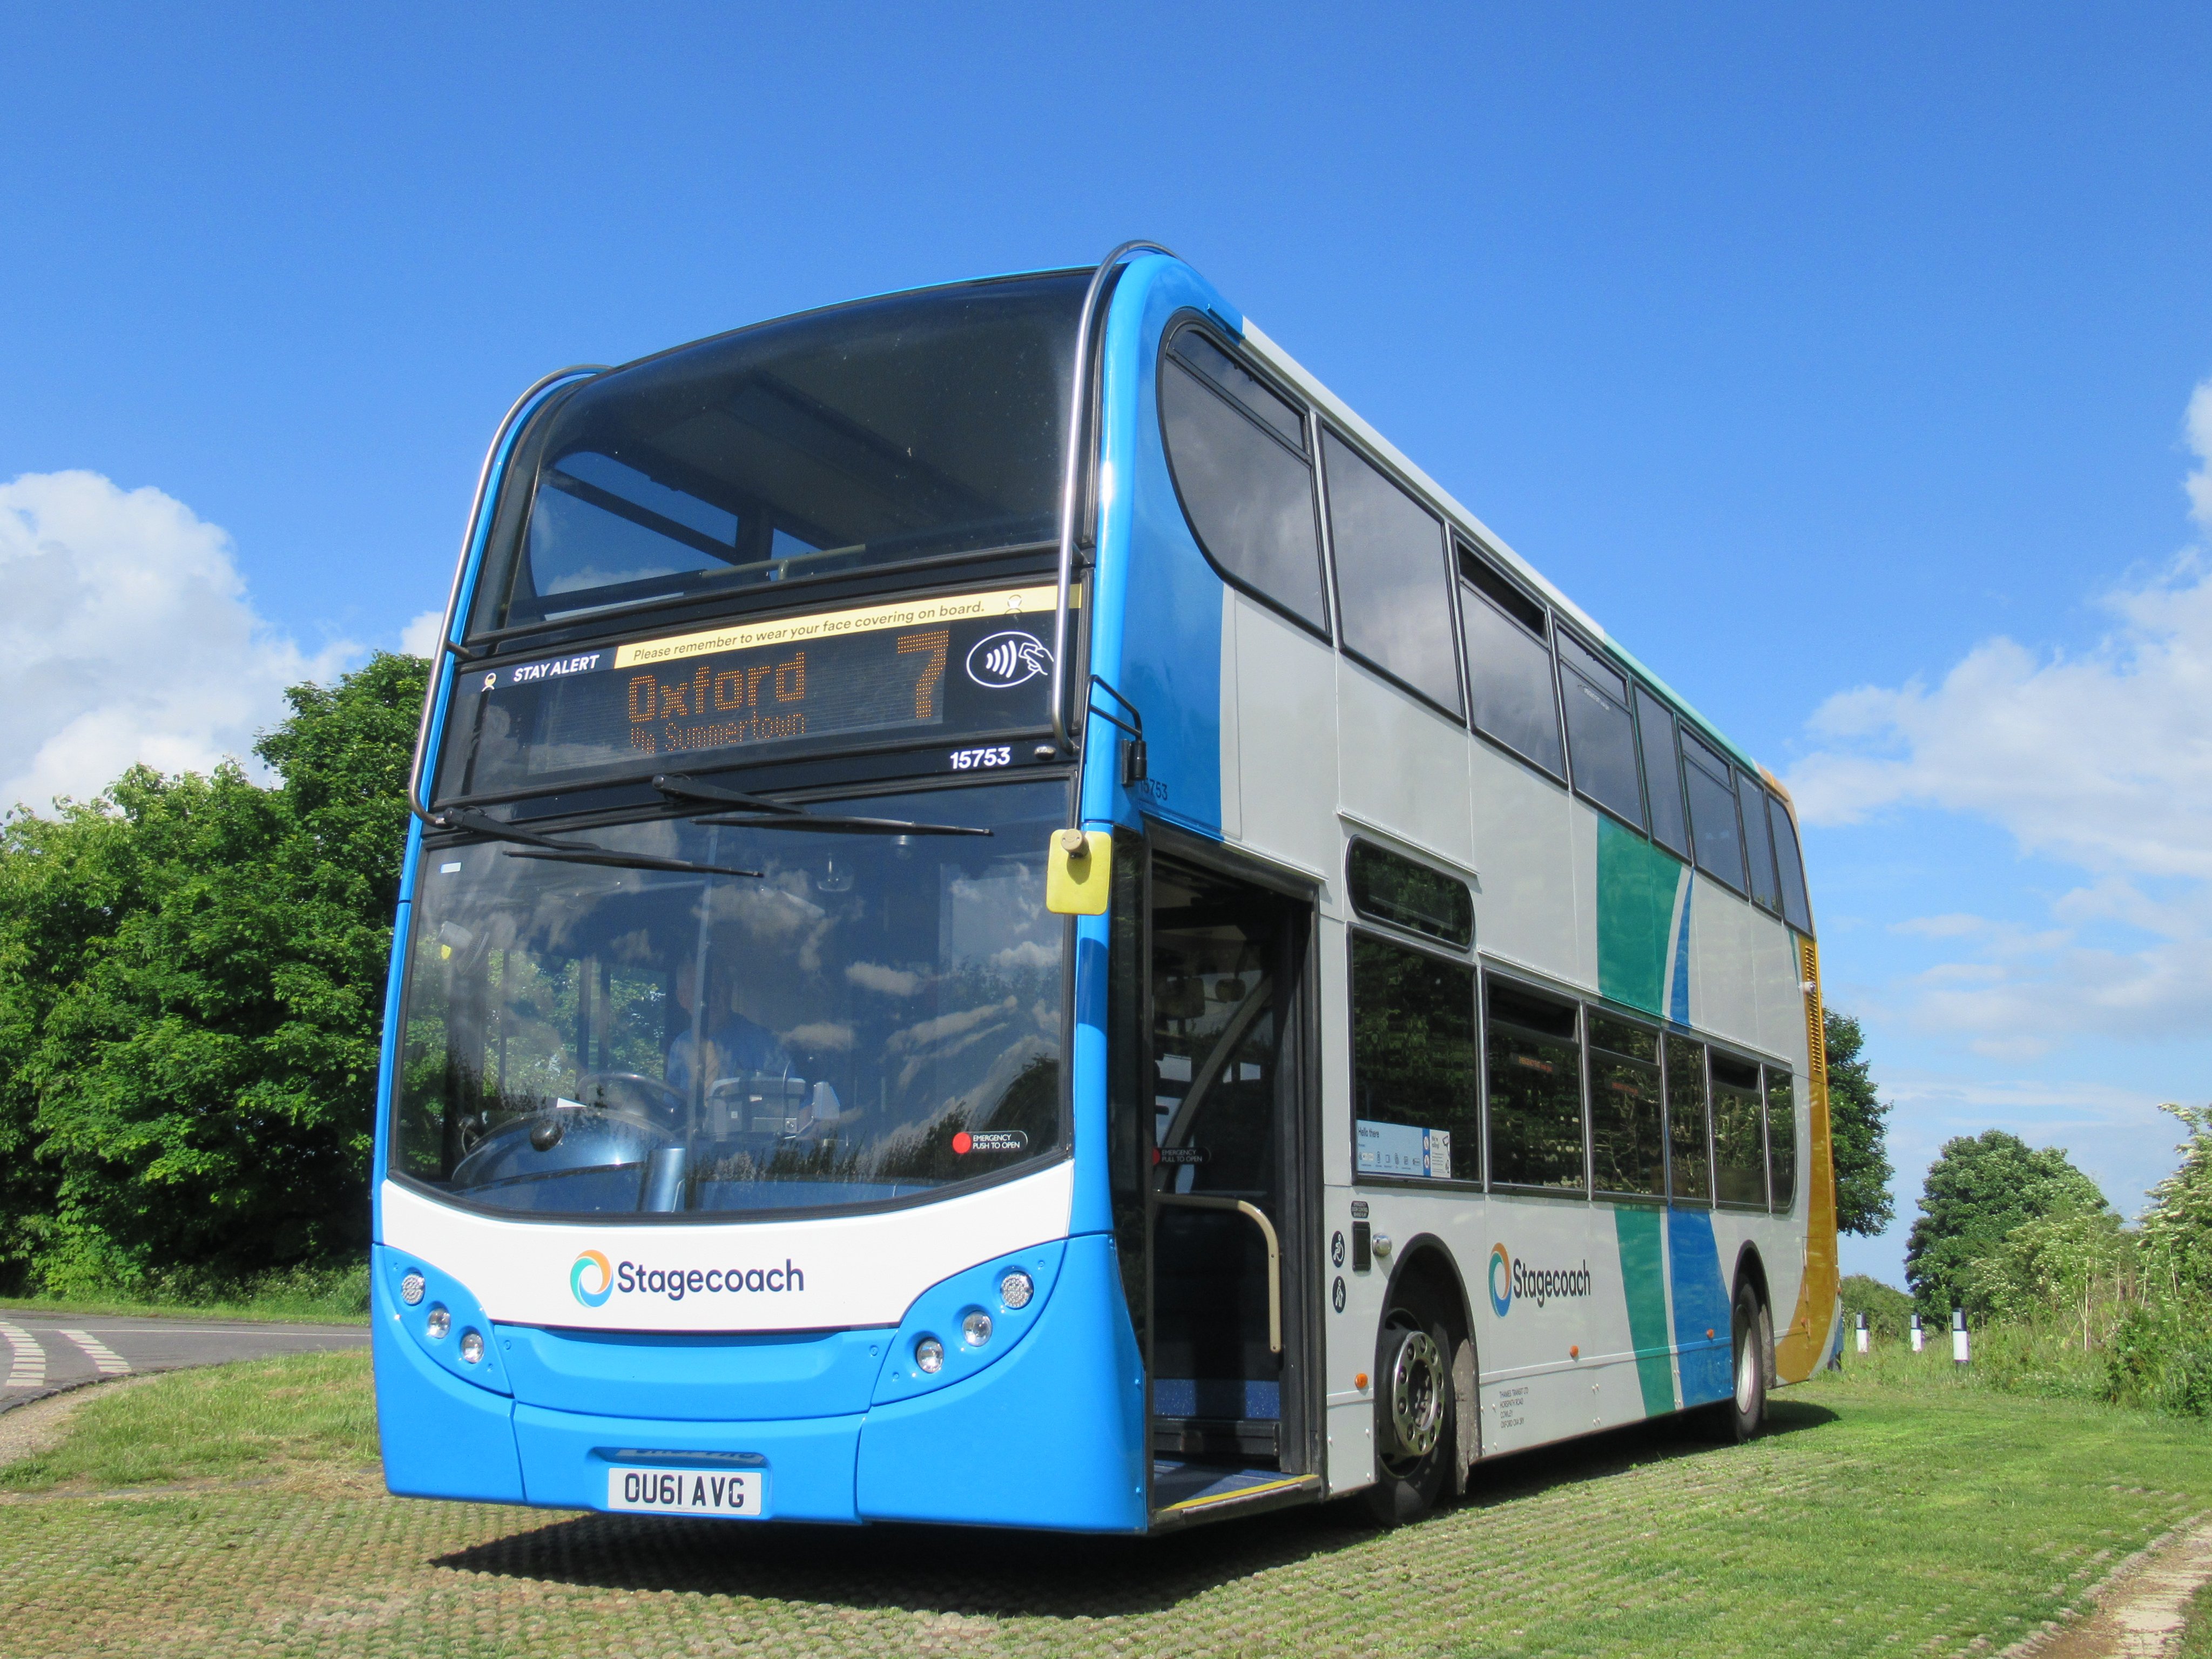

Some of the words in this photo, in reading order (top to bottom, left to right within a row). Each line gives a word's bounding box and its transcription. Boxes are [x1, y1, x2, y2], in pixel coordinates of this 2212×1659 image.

[633, 649, 670, 661] Please
[674, 636, 738, 655] remember
[740, 633, 752, 644] to
[756, 629, 787, 641] wear
[790, 623, 820, 639] your
[823, 620, 851, 632] face
[855, 610, 914, 627] covering
[918, 608, 935, 619] on
[940, 601, 985, 617] board.
[514, 663, 550, 682] STAY
[550, 654, 600, 676] ALERT
[629, 652, 805, 723] Oxford
[897, 630, 949, 718] 7
[665, 711, 805, 751] Summertown
[950, 746, 1011, 770] 15753
[973, 1134, 1011, 1142] EMERGENCY
[617, 1258, 805, 1301] Stagecoach
[1513, 1257, 1590, 1308] Stagecoach
[624, 1472, 683, 1505] OU61
[691, 1475, 745, 1508] AVG
